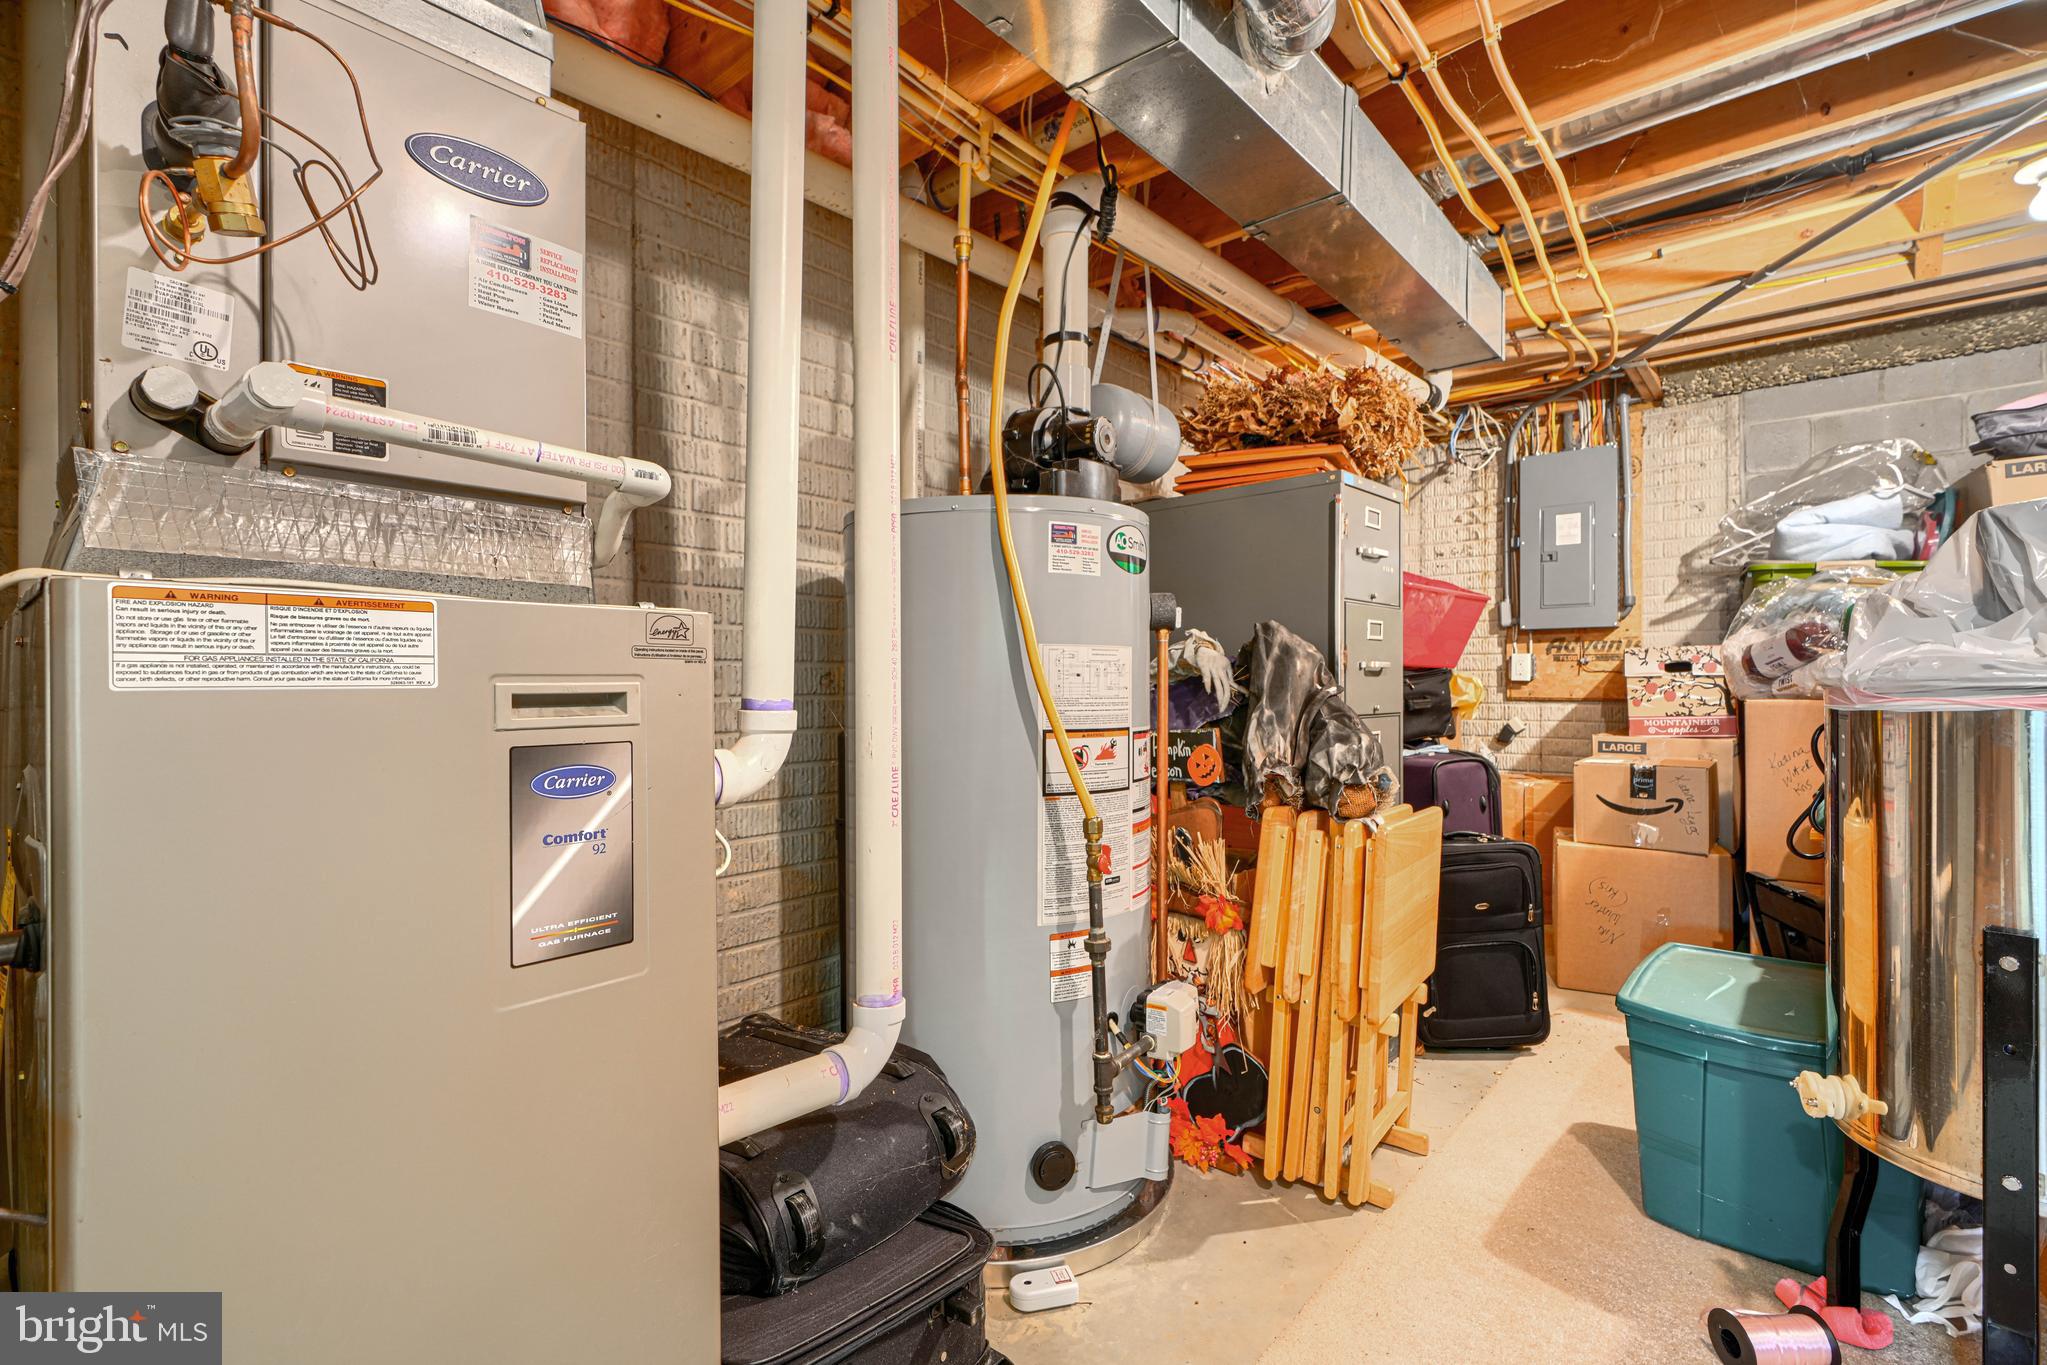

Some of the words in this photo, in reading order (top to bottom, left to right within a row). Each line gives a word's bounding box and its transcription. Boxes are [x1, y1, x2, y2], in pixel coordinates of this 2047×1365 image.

[429, 143, 531, 192] Carrier
[540, 248, 562, 260] SERVICE
[540, 256, 578, 274] REPLACEMENT
[486, 270, 567, 300] 410-529-3283
[519, 271, 542, 282] COMPANY
[553, 282, 563, 290] CAN
[155, 290, 192, 303] EVAPORATOR
[200, 344, 213, 358] UL
[216, 358, 226, 366] US
[322, 371, 358, 382] WARNING
[190, 592, 240, 601] WARNING
[336, 600, 406, 608] AVERTISSEMENT
[1668, 726, 1698, 735] apples
[1602, 743, 1642, 752] LARGE
[544, 772, 606, 791] Carrier
[1633, 777, 1654, 786] prime
[542, 828, 606, 847] Comfort
[592, 842, 606, 856] 92
[530, 920, 566, 934] ULTRA
[567, 912, 618, 928] EFFICIENT
[538, 938, 561, 948] GAS
[563, 928, 612, 942] FURNACE
